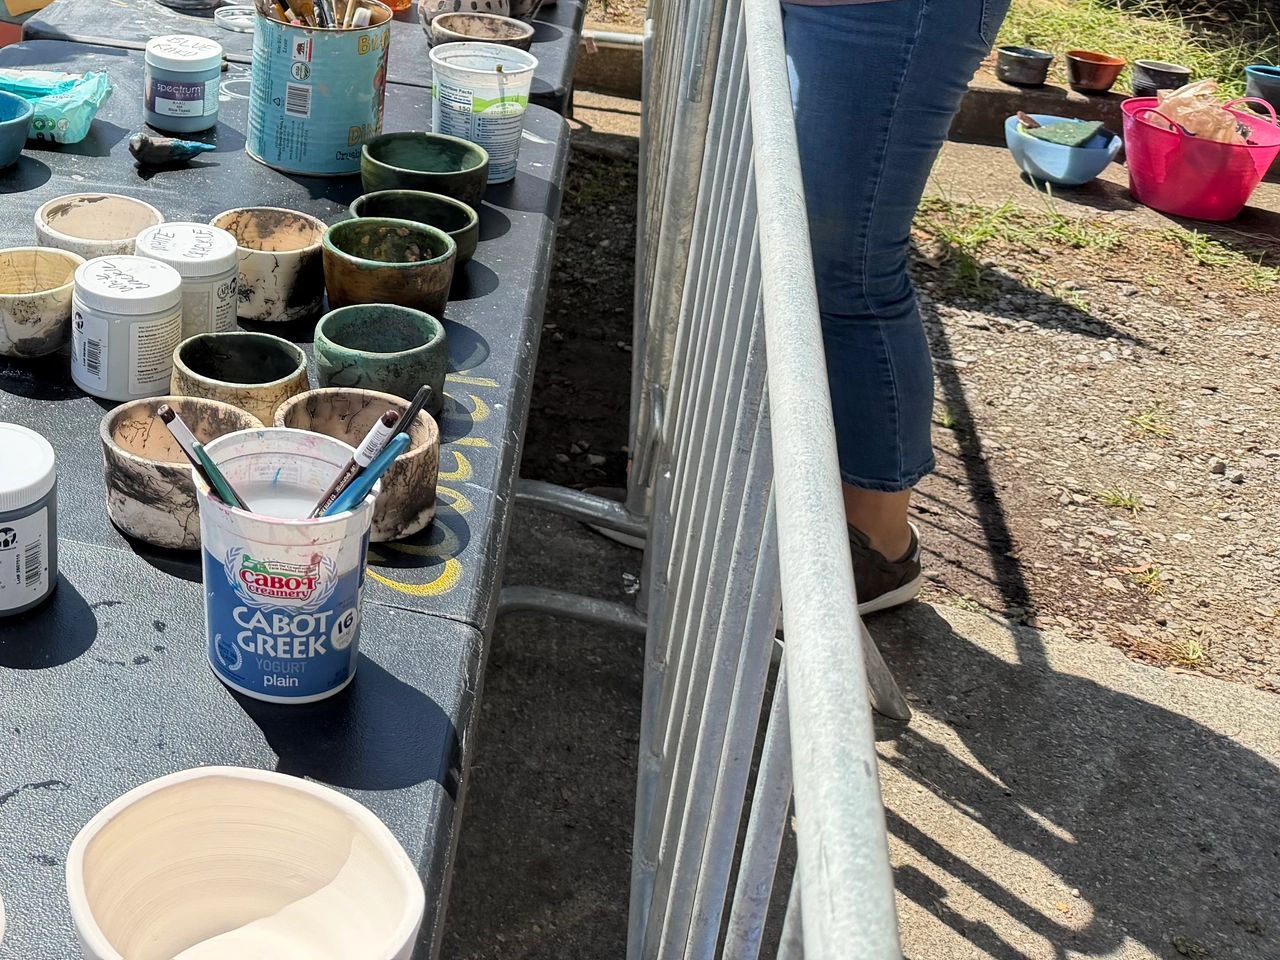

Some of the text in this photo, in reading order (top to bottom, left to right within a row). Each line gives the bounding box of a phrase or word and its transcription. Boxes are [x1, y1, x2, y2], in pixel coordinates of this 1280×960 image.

[166, 37, 218, 51] BLUE
[157, 82, 201, 95] spectrum
[232, 606, 334, 636] CABOT
[337, 612, 354, 635] 16
[236, 630, 328, 659] GREEK
[255, 656, 308, 674] YOGURT
[263, 674, 299, 688] plain
